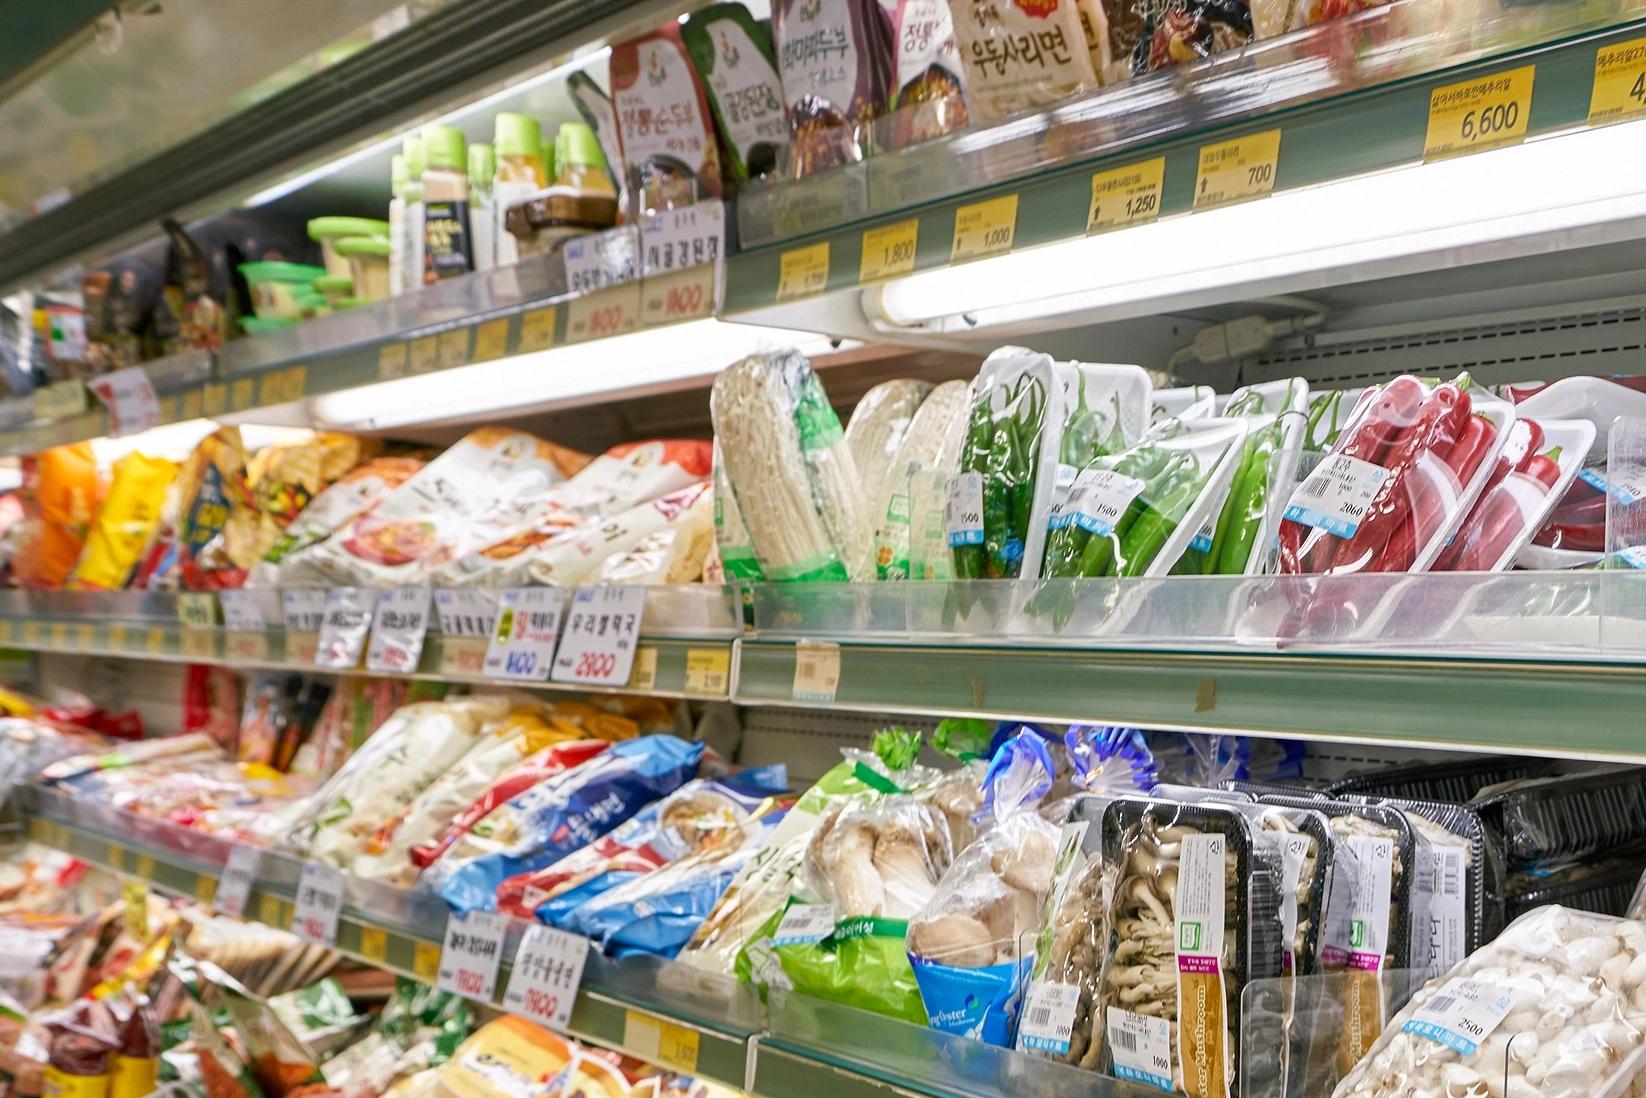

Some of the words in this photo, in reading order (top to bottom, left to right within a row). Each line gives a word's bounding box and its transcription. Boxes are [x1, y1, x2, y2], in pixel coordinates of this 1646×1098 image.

[971, 23, 1072, 79] 우동사리면
[1461, 101, 1518, 141] 6,600
[1248, 163, 1272, 186] 700
[1126, 193, 1157, 217] 1,250
[882, 239, 913, 268] 1,800
[1096, 503, 1118, 518] 1500
[1339, 502, 1364, 518] 2060
[1194, 985, 1208, 1066] Mushroom
[1348, 980, 1362, 1054] Mushroom
[1457, 1016, 1484, 1036] 2500
[1152, 1056, 1169, 1070] 1000
